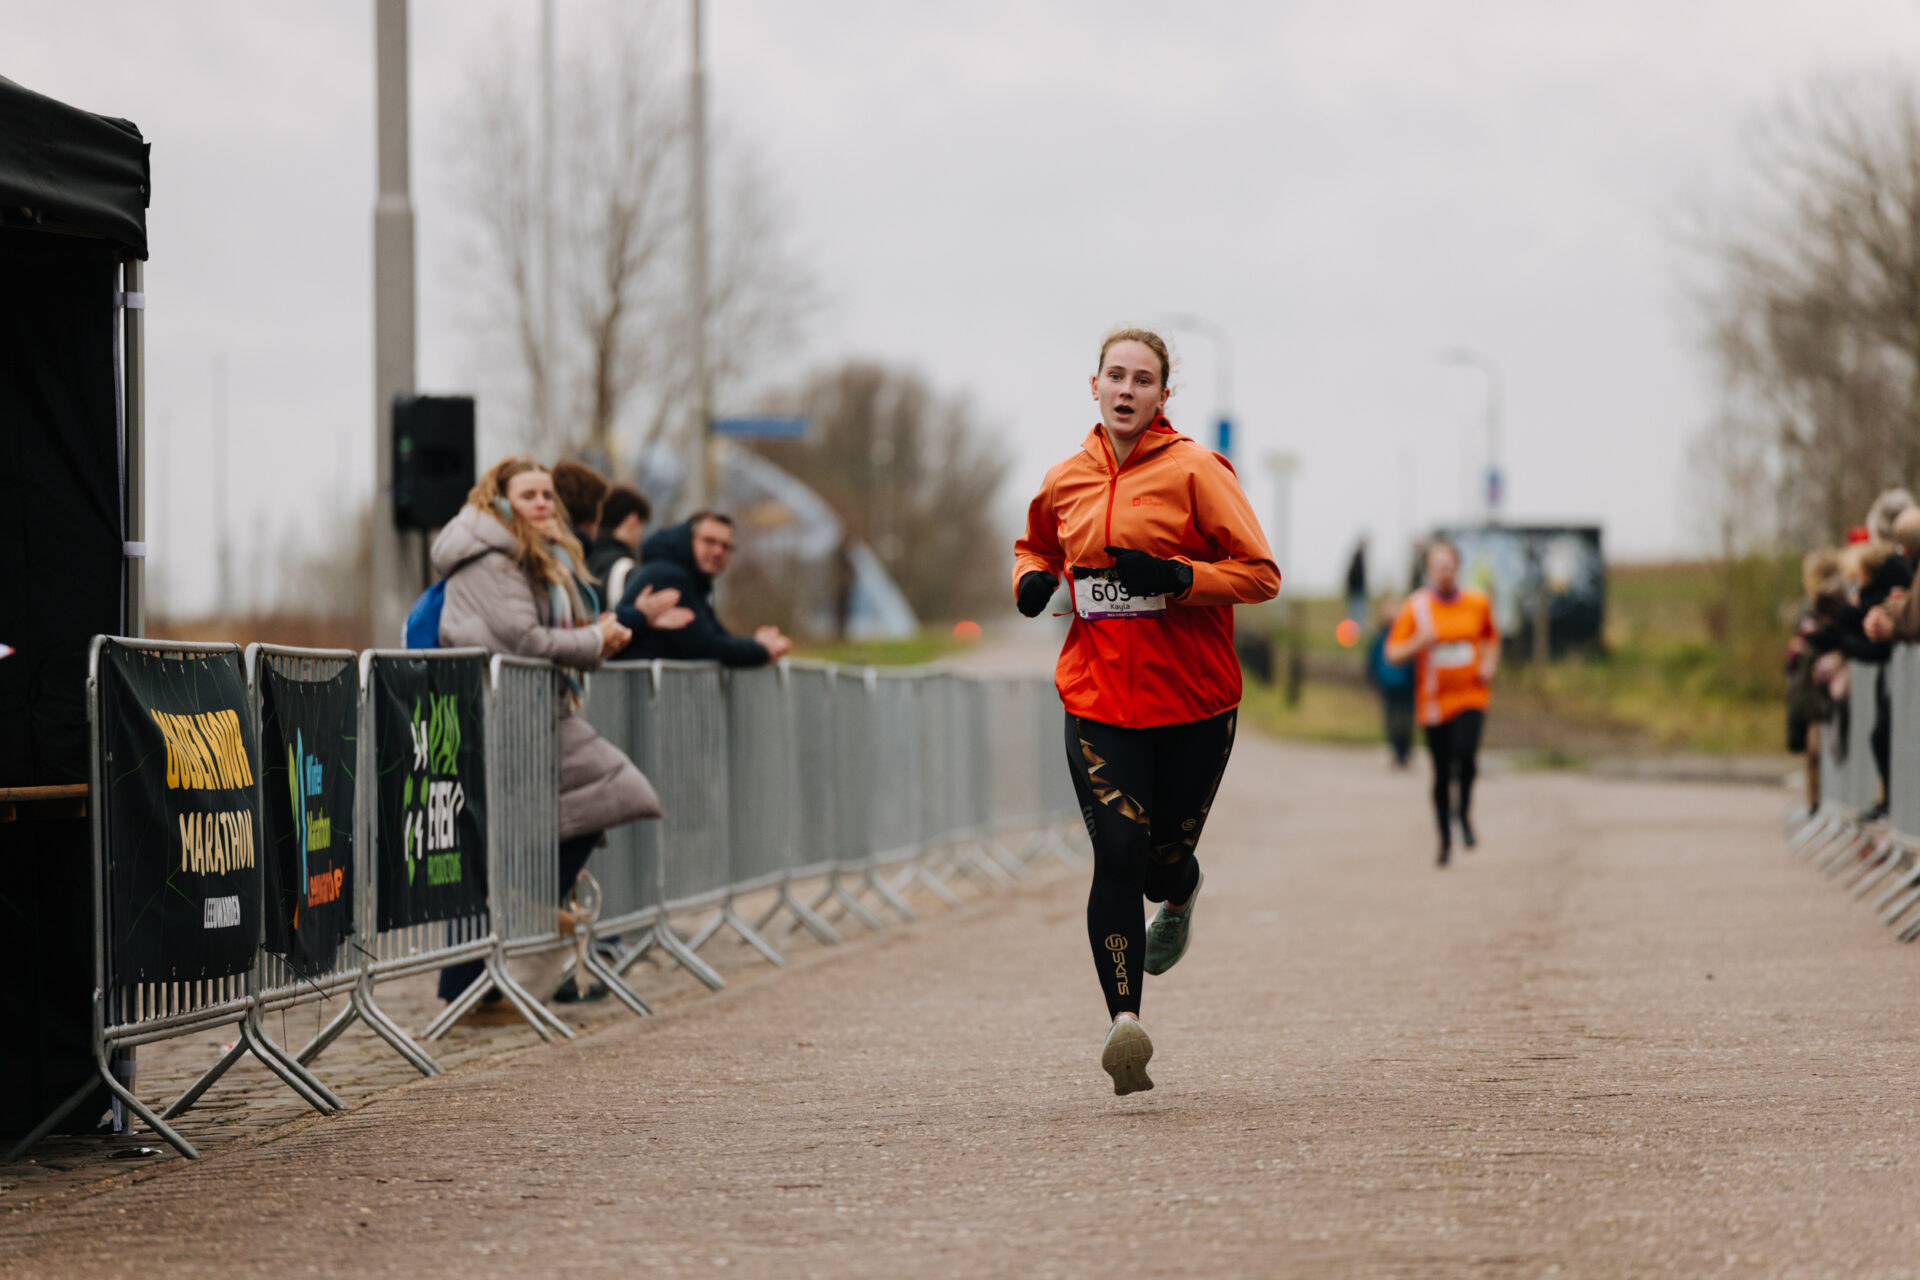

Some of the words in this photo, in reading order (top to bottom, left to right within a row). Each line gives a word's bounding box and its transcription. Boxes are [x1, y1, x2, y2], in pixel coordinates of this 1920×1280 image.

[1091, 582, 1147, 602] 609
[1109, 603, 1131, 611] Kayla
[150, 708, 221, 790] GOLDEN
[195, 708, 254, 790] HOUR
[179, 808, 255, 876] MARATHON
[203, 894, 241, 929] LEEUWARDEN
